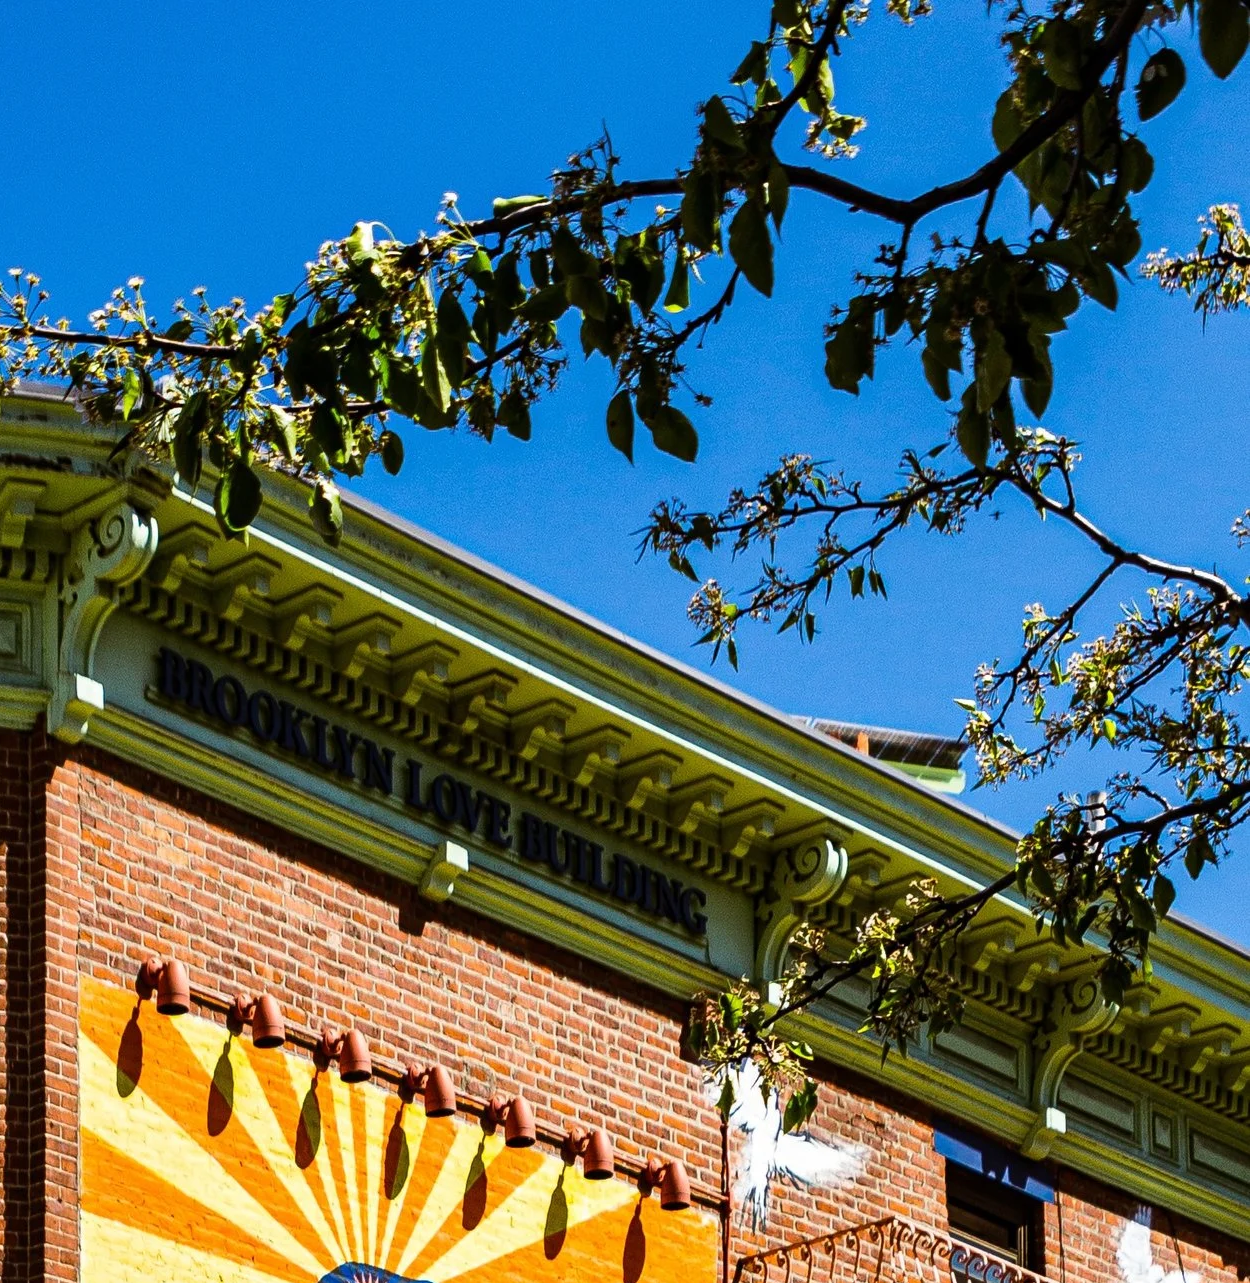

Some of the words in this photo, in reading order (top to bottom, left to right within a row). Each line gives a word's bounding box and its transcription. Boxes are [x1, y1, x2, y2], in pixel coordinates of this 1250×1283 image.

[158, 646, 395, 796] BROOKLYN
[406, 758, 514, 847] LOVE
[521, 811, 708, 935] BUILDING
